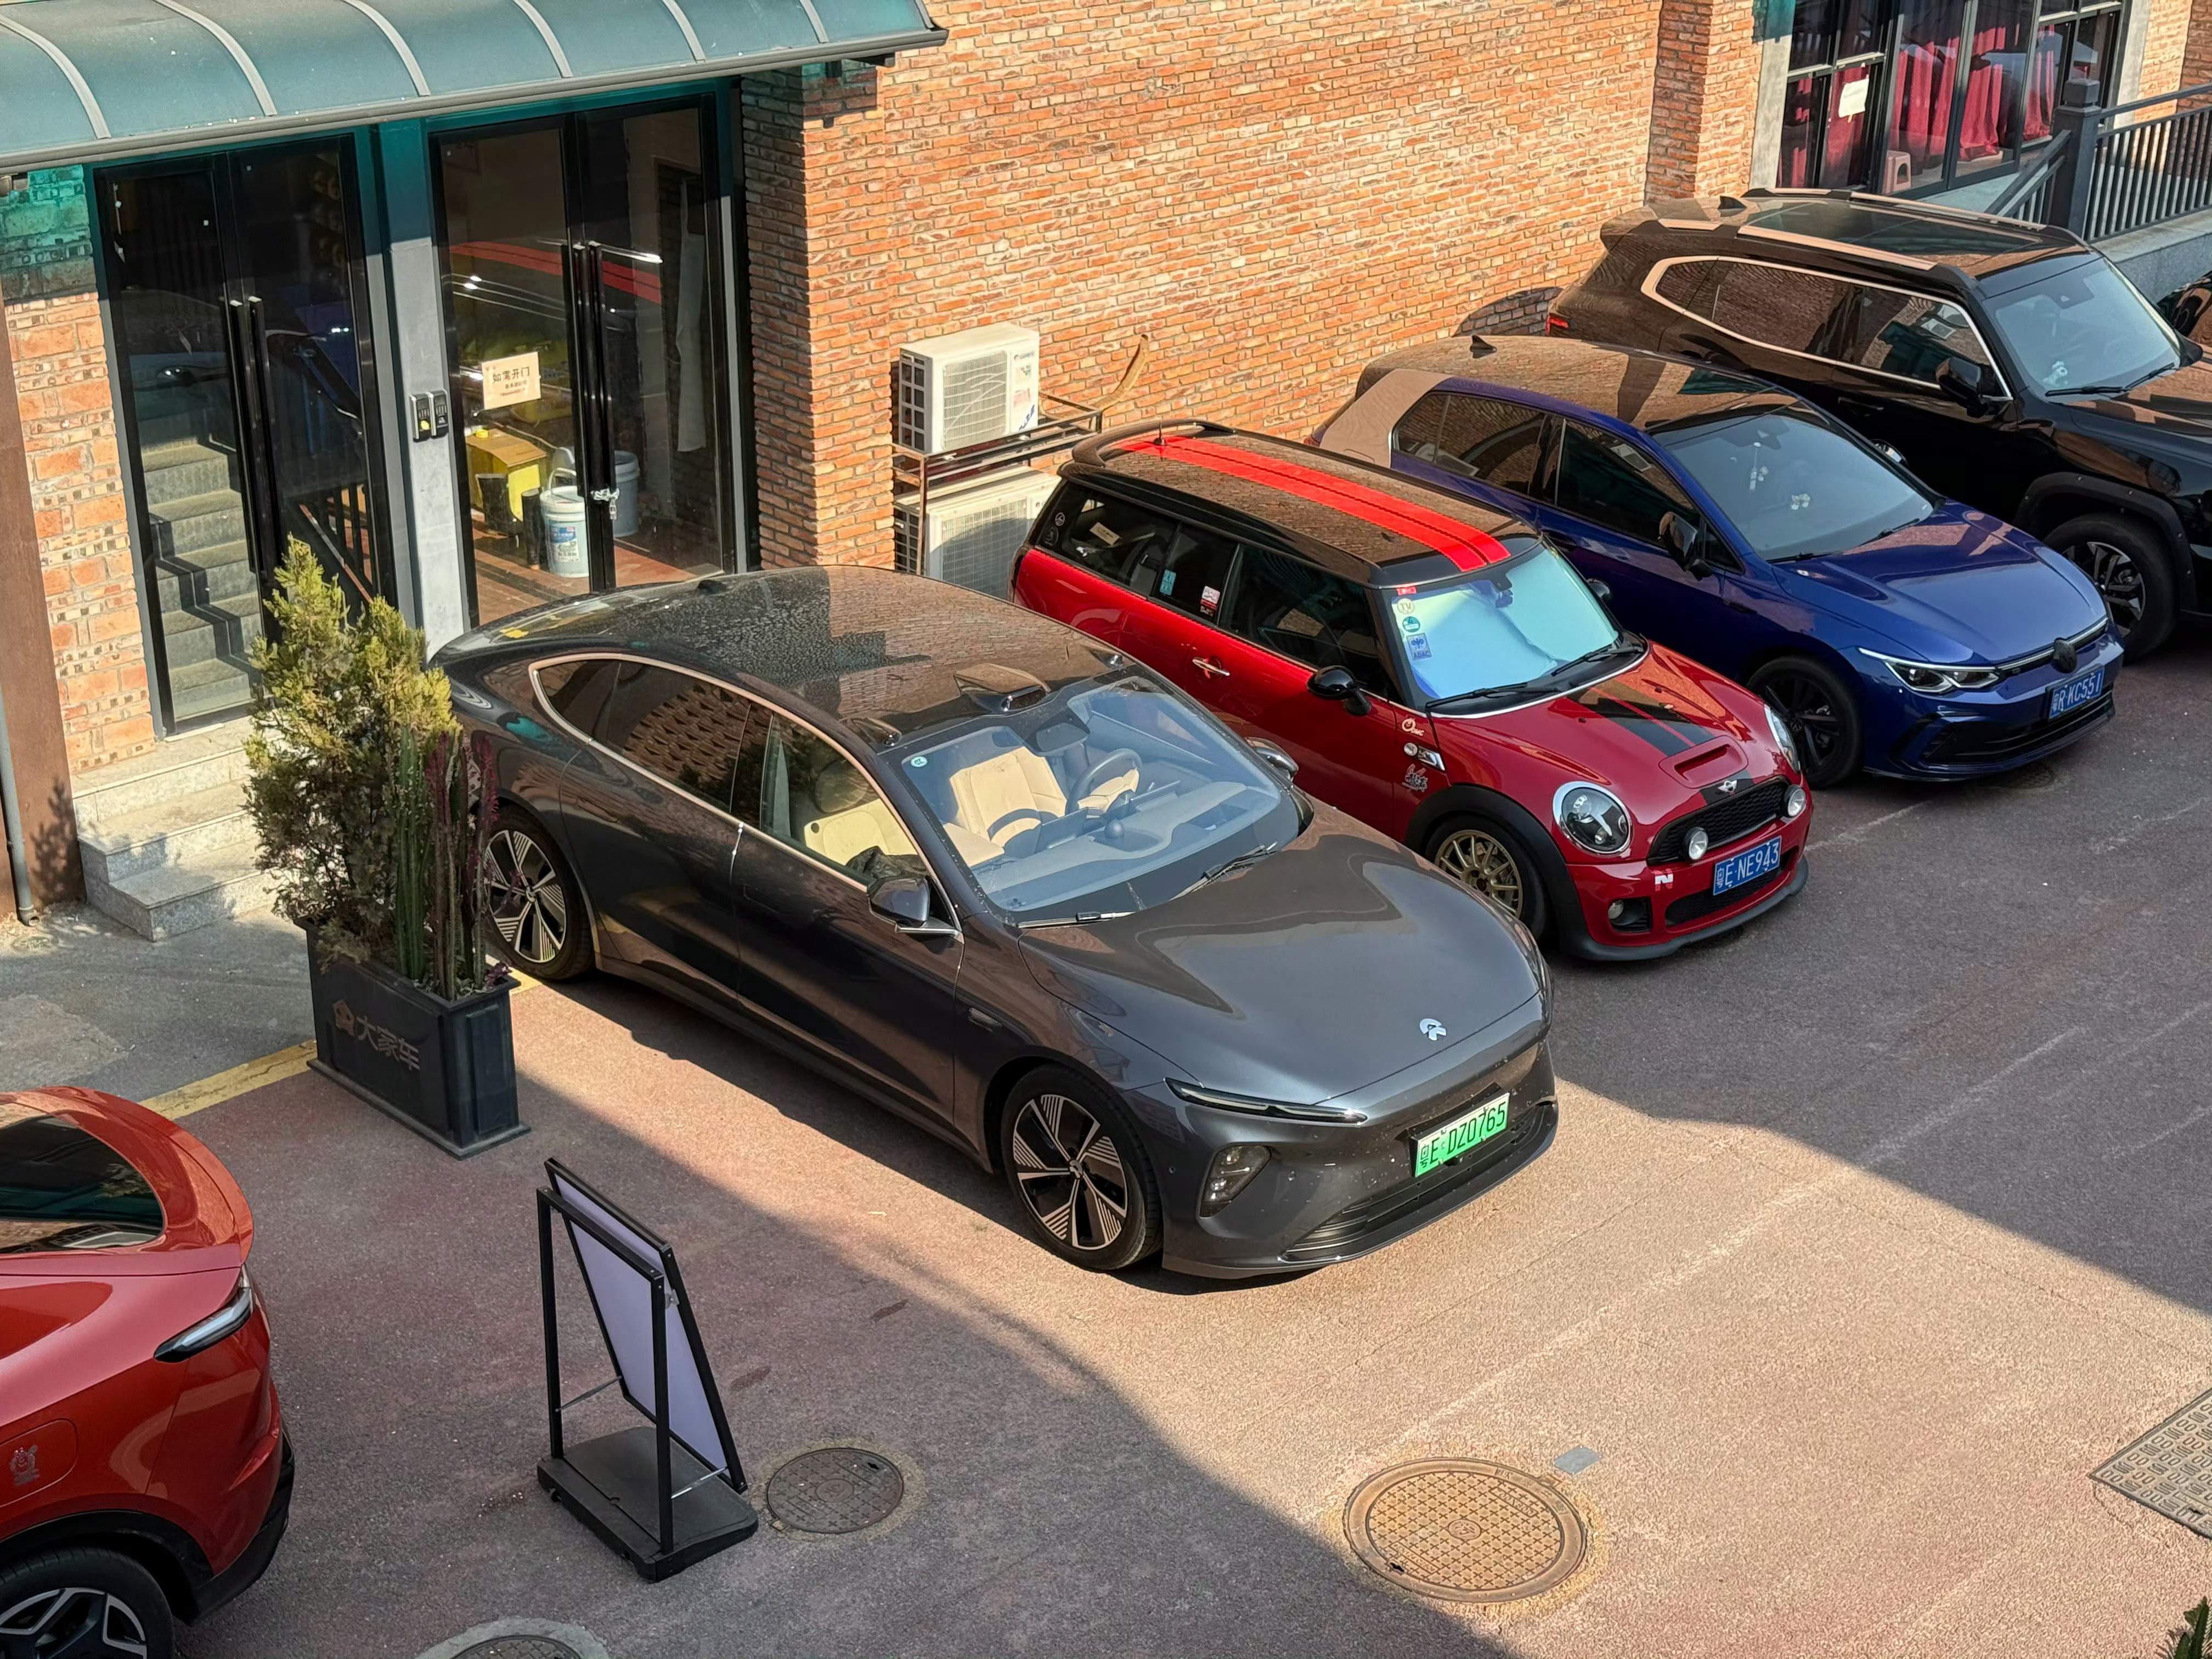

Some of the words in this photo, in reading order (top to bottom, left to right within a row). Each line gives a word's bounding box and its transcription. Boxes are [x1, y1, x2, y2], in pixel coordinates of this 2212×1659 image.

[492, 366, 530, 384] 如需开门
[1413, 651, 1430, 659] ADAC
[357, 1015, 420, 1071] 大家车
